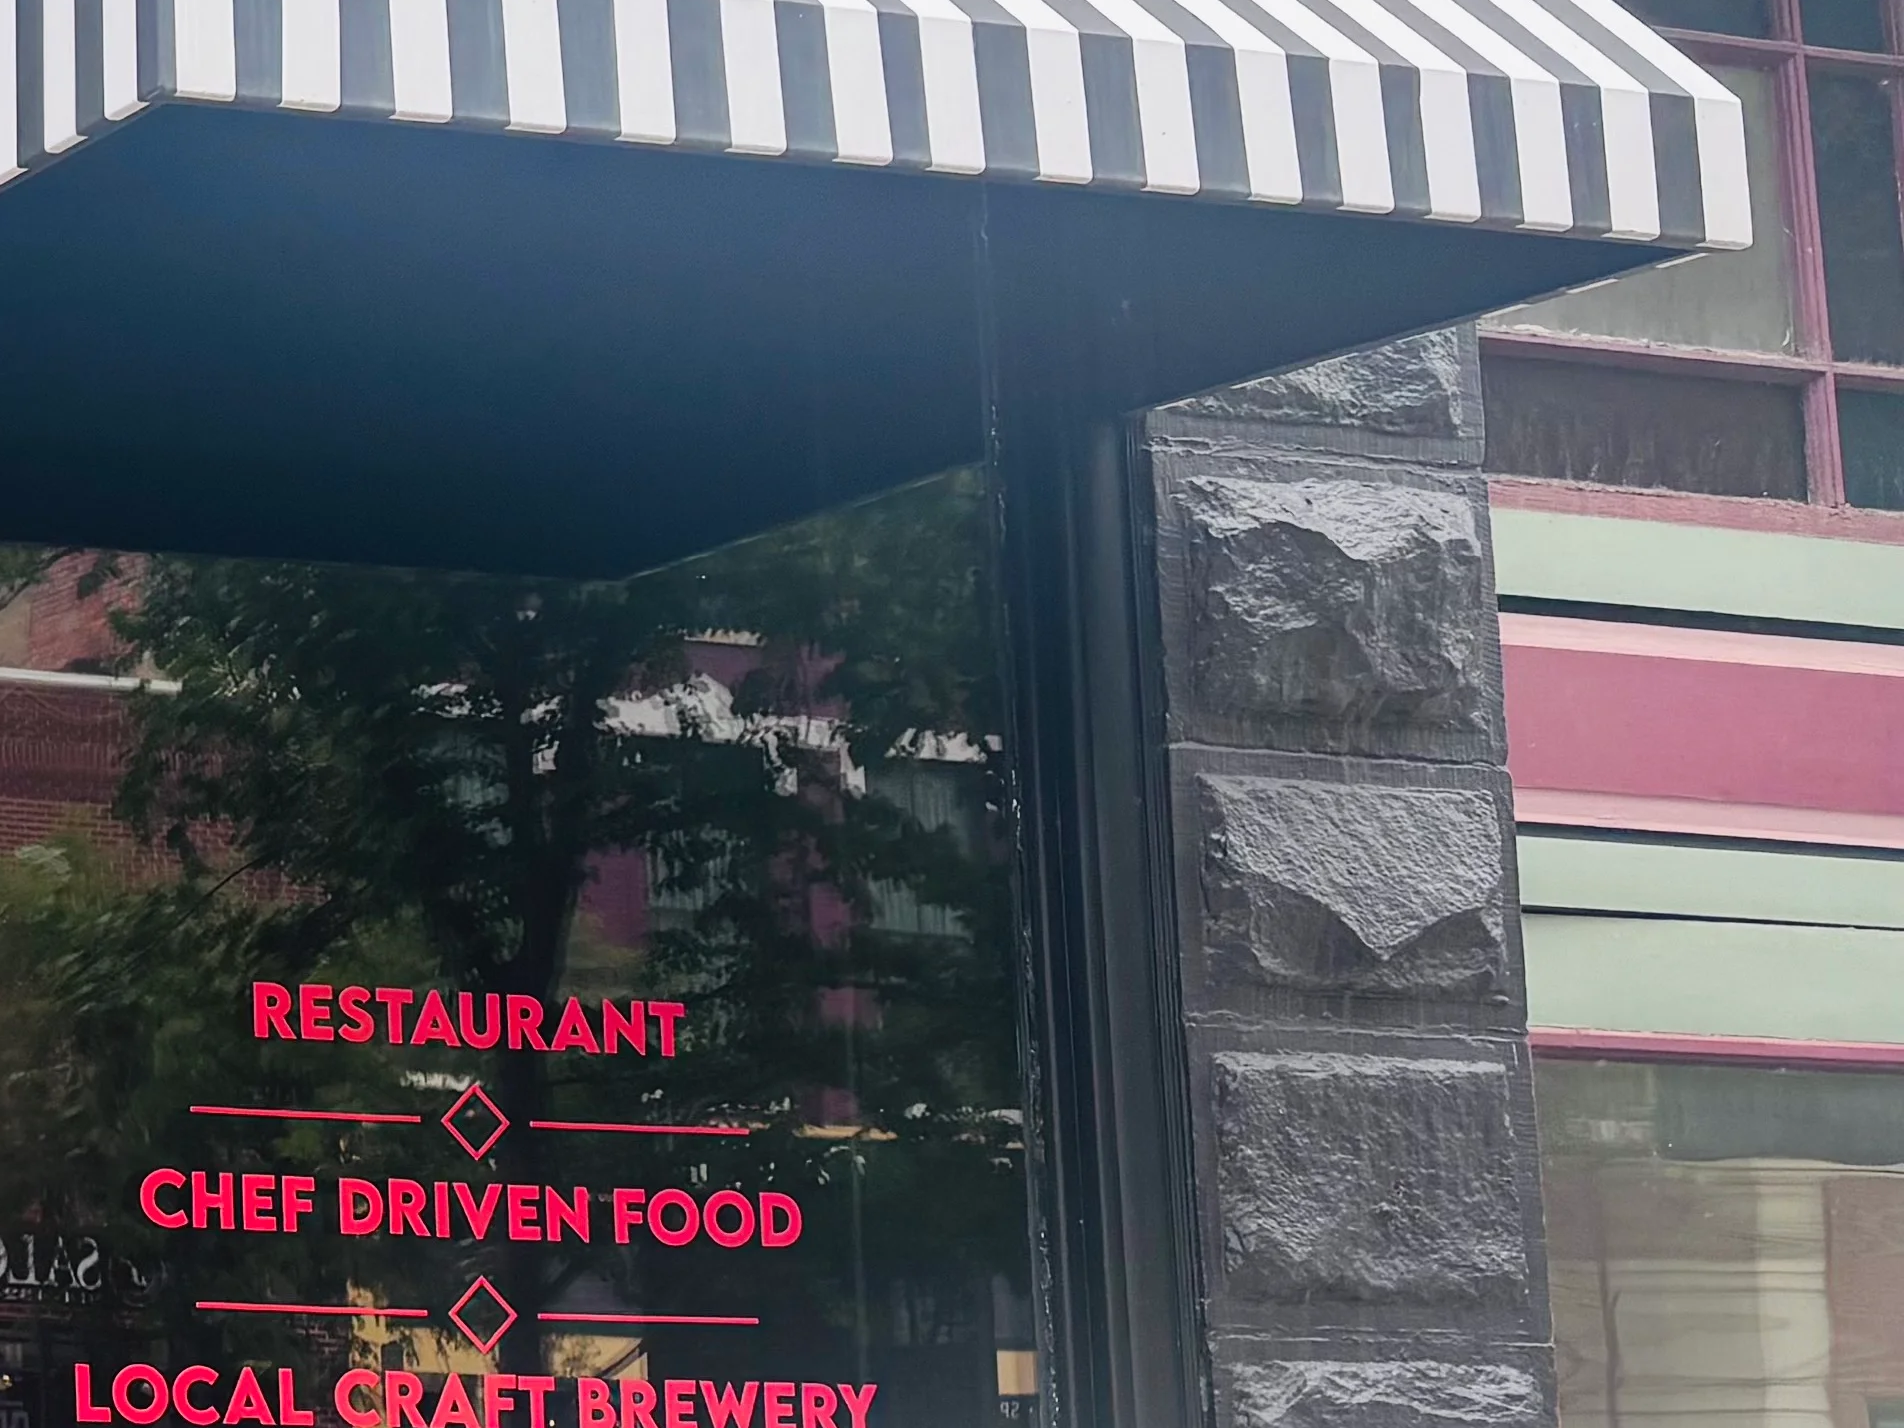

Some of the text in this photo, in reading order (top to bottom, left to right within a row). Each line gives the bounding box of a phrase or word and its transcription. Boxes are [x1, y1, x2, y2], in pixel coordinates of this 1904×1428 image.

[252, 981, 685, 1058] RESTAURANT
[139, 1168, 803, 1249] CHEF DRIVEN FOOD
[74, 1363, 314, 1427] LOCAL
